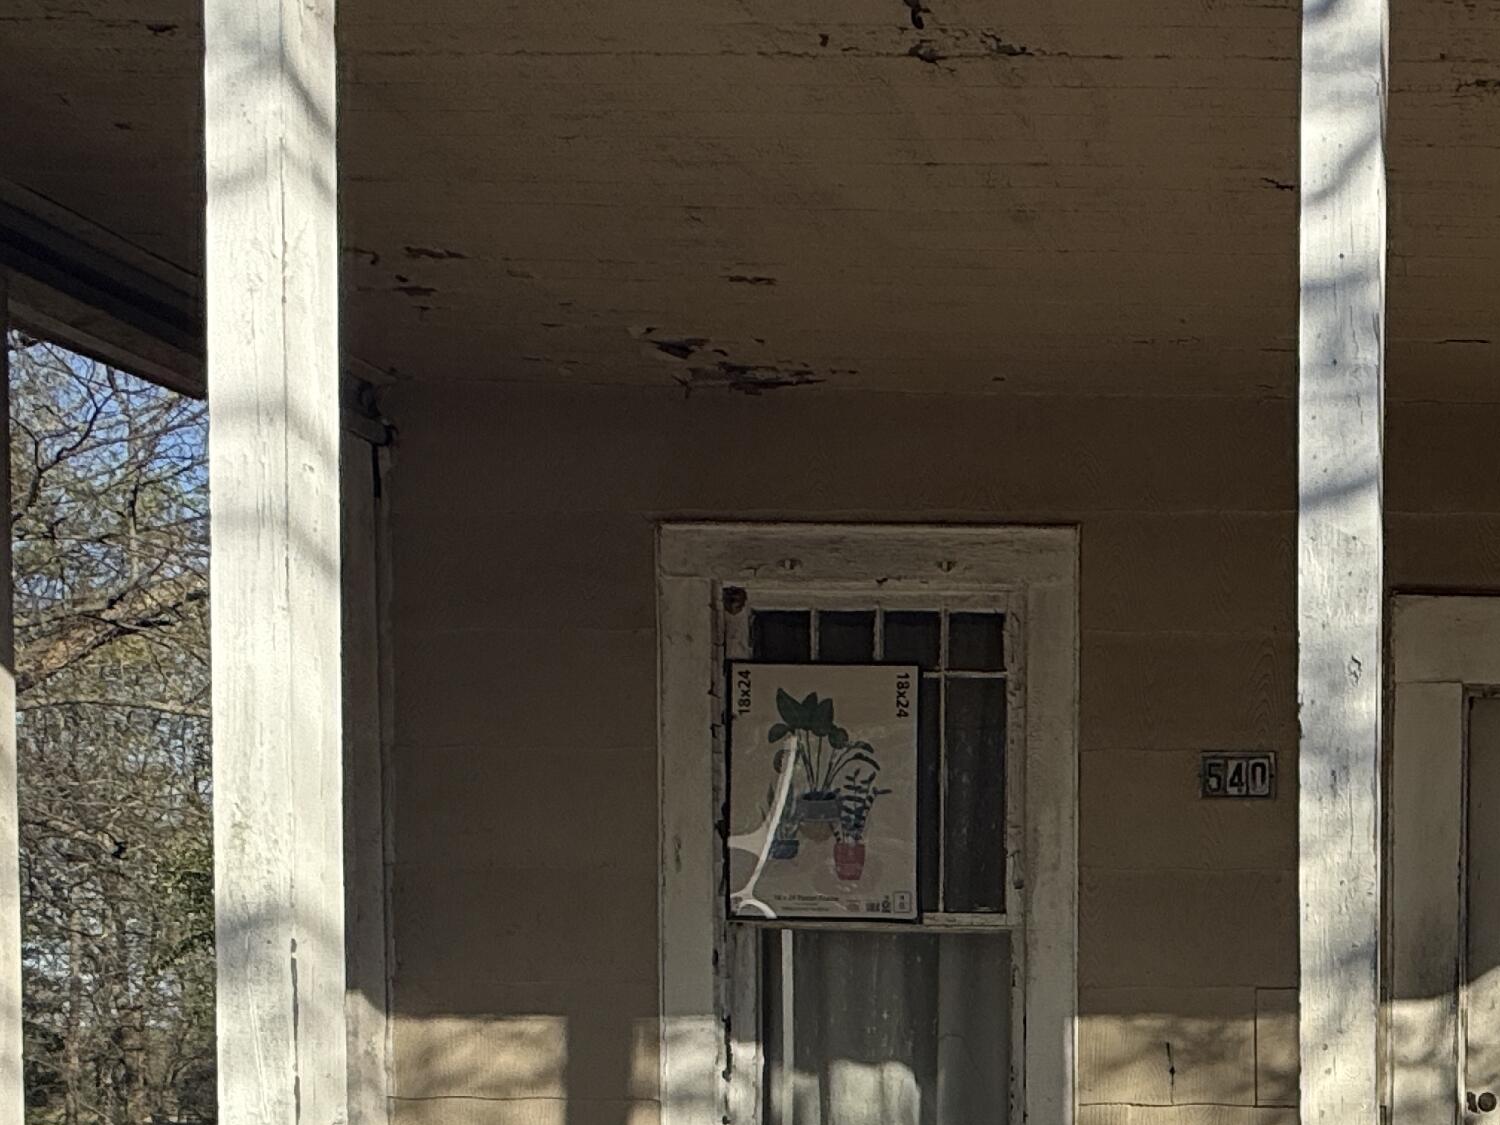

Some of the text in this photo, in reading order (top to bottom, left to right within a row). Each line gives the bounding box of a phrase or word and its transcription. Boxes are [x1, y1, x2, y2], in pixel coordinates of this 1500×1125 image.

[737, 669, 752, 716] 18x24
[896, 672, 910, 718] 18x24
[1208, 761, 1267, 793] 540
